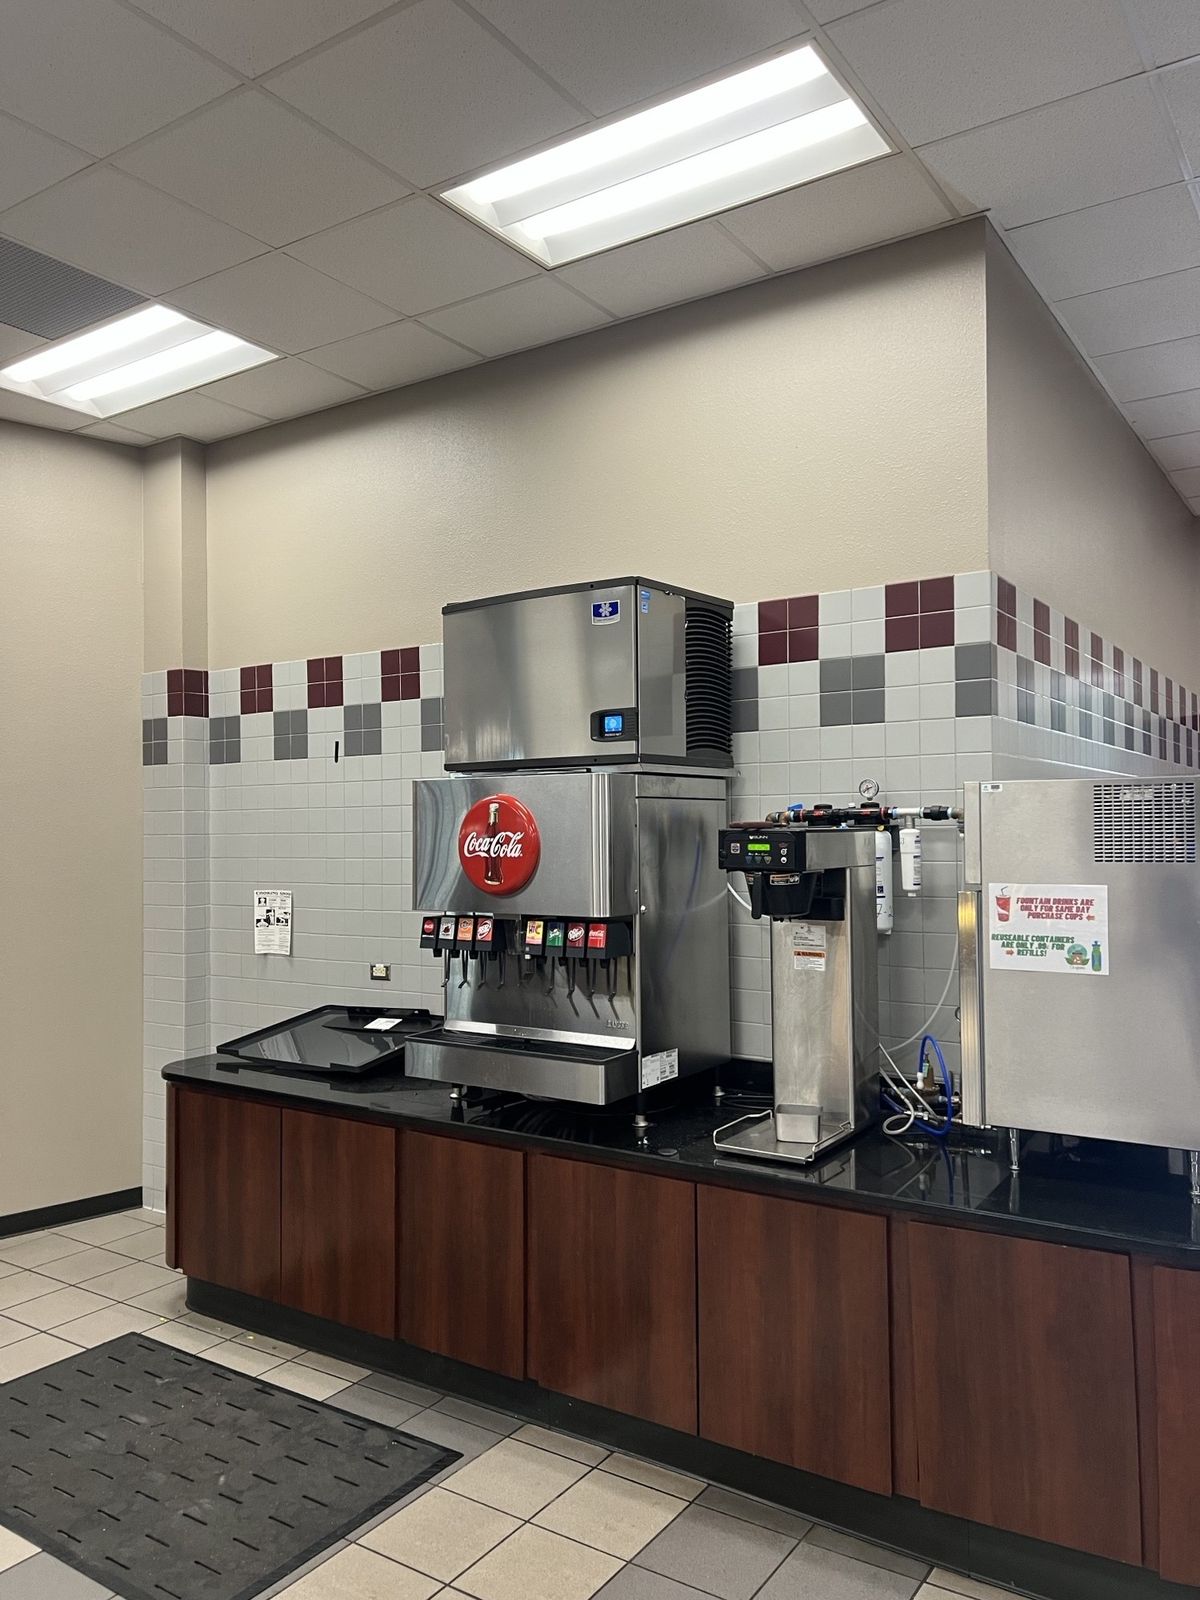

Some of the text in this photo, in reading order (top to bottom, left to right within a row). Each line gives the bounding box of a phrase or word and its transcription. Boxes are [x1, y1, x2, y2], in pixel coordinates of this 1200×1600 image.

[464, 831, 524, 858] Coca-Cola
[1080, 898, 1095, 906] ARE
[1020, 904, 1091, 914] ONLY FOR SAME DAY
[1027, 912, 1063, 920] PURCHASE
[991, 934, 1030, 942] REUSEABLE
[1015, 941, 1034, 949] ONLY
[1017, 949, 1047, 957] REFILLS!
